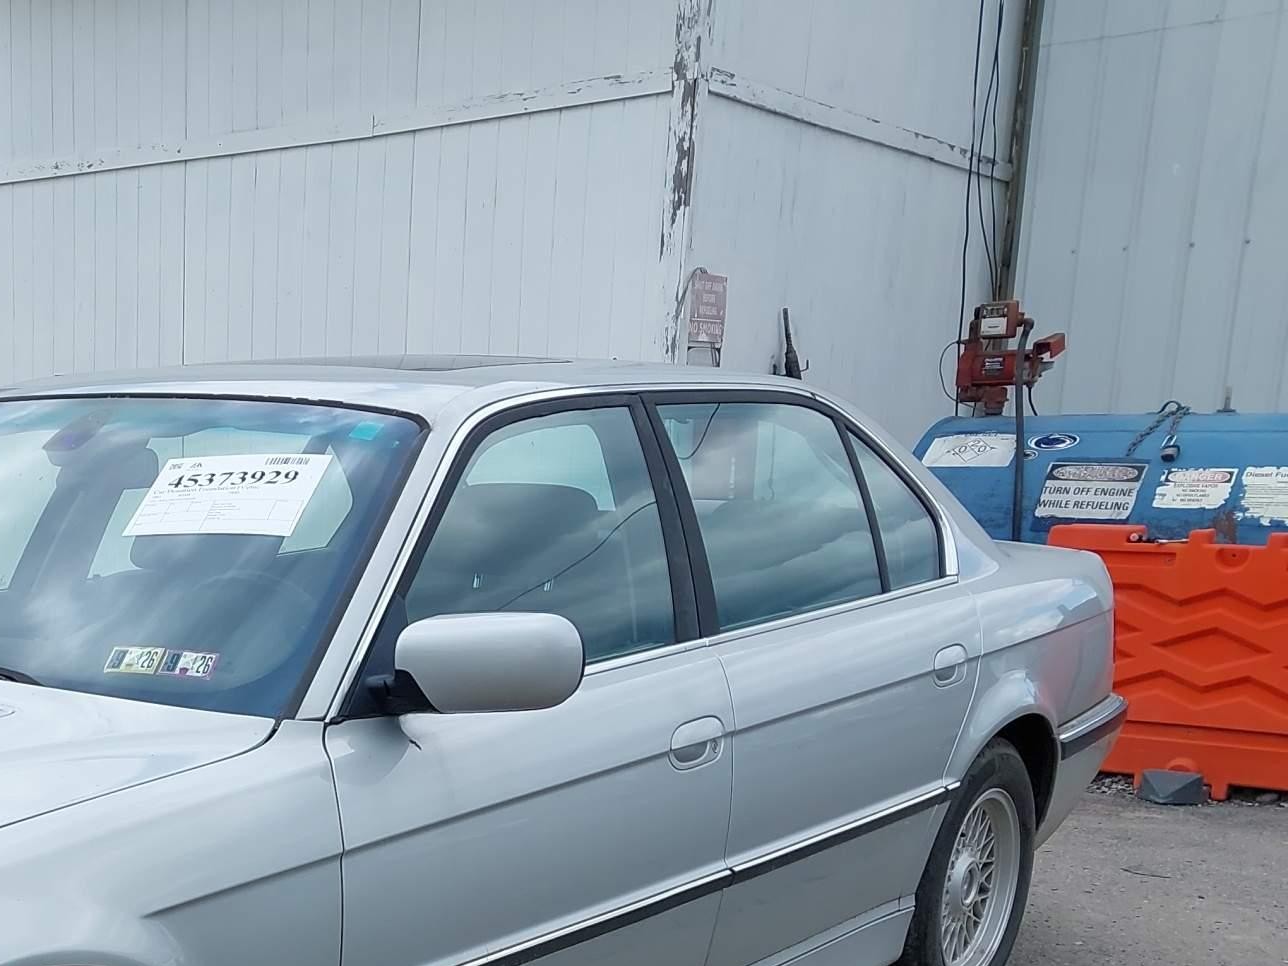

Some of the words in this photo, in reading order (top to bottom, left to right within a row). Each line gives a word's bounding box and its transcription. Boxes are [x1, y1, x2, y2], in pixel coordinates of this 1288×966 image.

[168, 469, 300, 489] 45373929
[1043, 485, 1071, 496] TURN
[1073, 486, 1093, 496] OFF
[1094, 487, 1135, 498] ENGINE
[1038, 498, 1071, 509] WHILE
[1072, 500, 1130, 511] REFUELING
[167, 653, 180, 672] 9
[196, 655, 213, 674] 26
